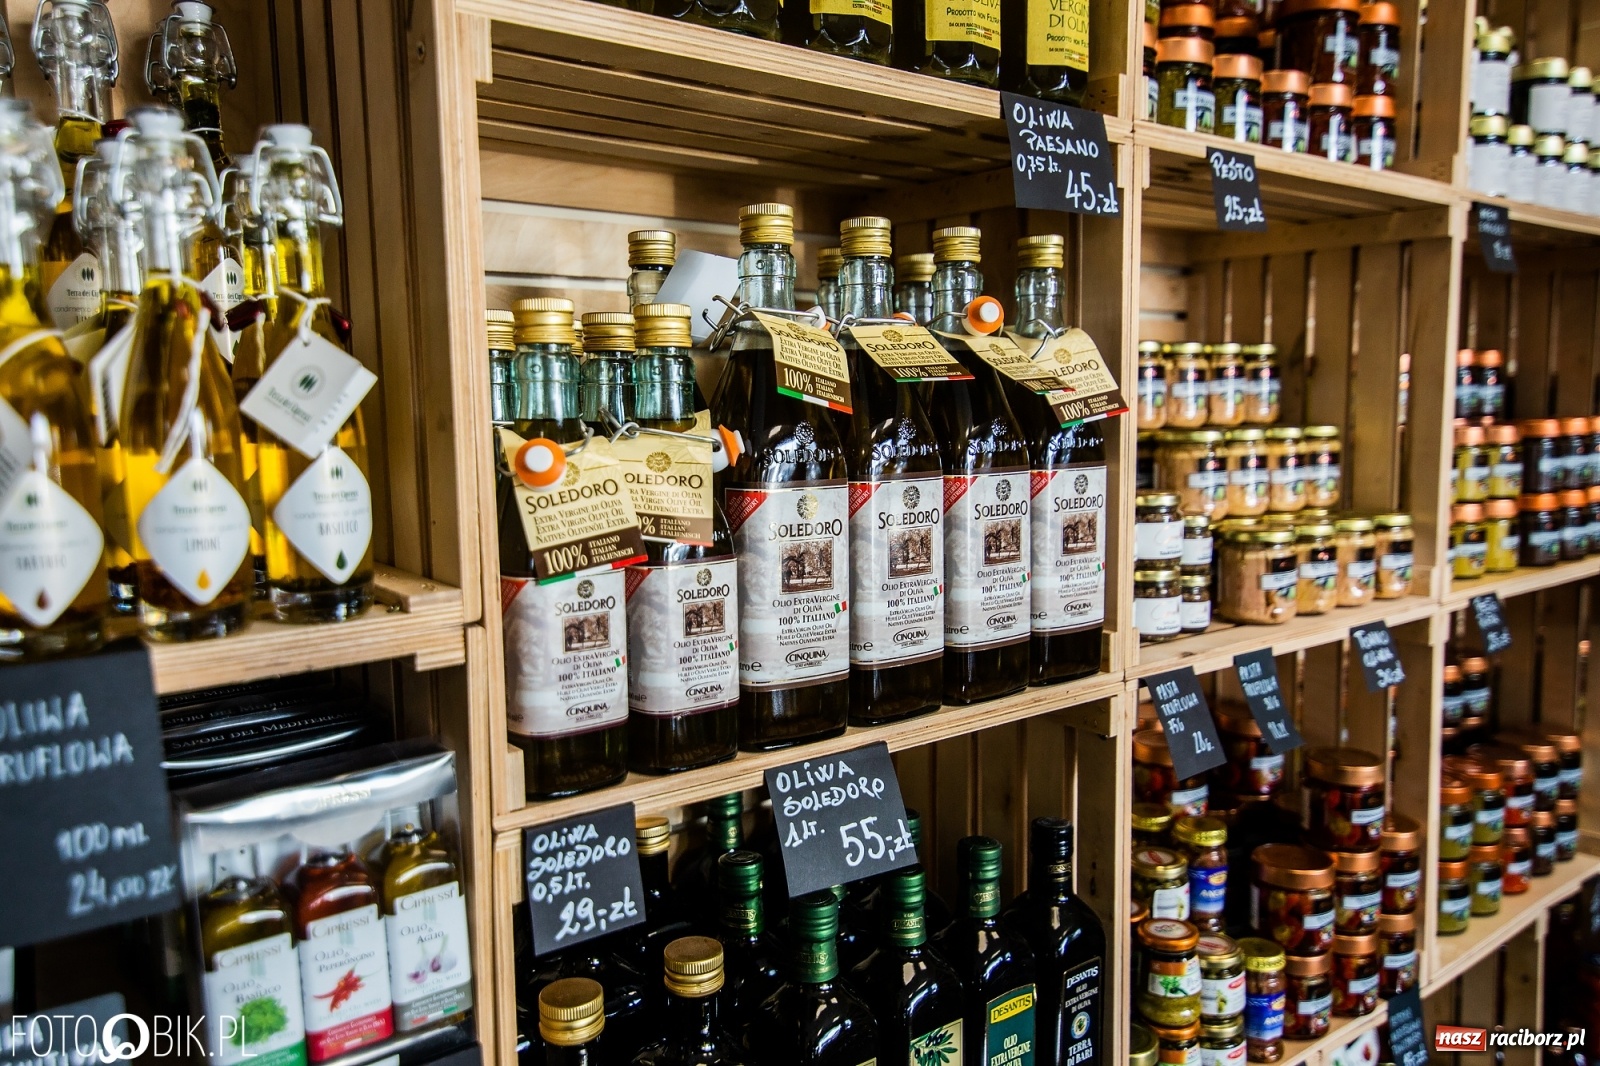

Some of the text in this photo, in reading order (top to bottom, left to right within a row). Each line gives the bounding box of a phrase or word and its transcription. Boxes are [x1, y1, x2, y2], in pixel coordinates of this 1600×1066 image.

[947, 7, 976, 17] PRODOTTO
[1049, 14, 1064, 28] DI
[1019, 129, 1099, 158] PAESANO
[1210, 151, 1254, 182] PESTO
[770, 326, 839, 352] SOLEDORO
[780, 337, 796, 349] EXTRA
[797, 342, 819, 355] VERGINE
[866, 341, 935, 353] SOLEDORO
[780, 352, 844, 378] NATIVES EXTRA
[781, 345, 842, 370] EXTRA VIRGIN OLIVE OIL
[986, 354, 1031, 366] SOLEDORO
[893, 366, 929, 378] 100%
[1050, 359, 1100, 378] OLEDORO
[783, 368, 813, 393] 100%
[1059, 400, 1090, 421] 100%
[624, 472, 703, 489] OLEDORO
[526, 478, 619, 515] SOLEDORO
[641, 488, 669, 497] VERGINE
[681, 490, 702, 499] OLIVA
[641, 496, 701, 507] VIRGIN OLIVE OIL
[1054, 494, 1104, 512] SOLEDORO
[533, 499, 623, 525] EXTRA VERGINE DI OLIVA
[682, 507, 704, 515] EXTRA
[878, 508, 940, 529] SOLEDORO
[974, 500, 1028, 520] SOLEDORO
[536, 507, 625, 535] EXTRA VIRGIN OLIVE OIL
[660, 518, 691, 526] ITALIANO
[660, 524, 686, 532] ITALIAN
[768, 518, 843, 541] SOLEDORO
[536, 517, 630, 545] NATIVES EXTRA
[544, 535, 620, 574] 100% ITALIANO
[591, 544, 617, 555] ITALIAN
[593, 547, 634, 563] ITALIENISCH
[677, 584, 730, 603] SOLEDORO
[981, 584, 998, 594] 100%
[555, 595, 616, 617] SOLEDORO
[772, 599, 792, 608] OLIO
[802, 604, 823, 614] OLIVA
[887, 594, 935, 608] 100% ITALIANO
[778, 612, 836, 626] 100% ITALIANO
[679, 656, 699, 665] 100%
[789, 649, 827, 662] CINQUINA
[230, 729, 259, 738] DEL
[0, 732, 135, 785] RUFLOWA
[783, 776, 884, 817] SOLEDORO
[56, 822, 110, 862] 100
[527, 835, 631, 881] SOLEDORO
[400, 889, 454, 911] CIPRESSI
[312, 915, 370, 939] CIPRESSI
[400, 923, 428, 936] OLIO
[417, 930, 444, 944] AGLIO
[1066, 966, 1099, 988] DESANTIS
[993, 996, 1031, 1020] DESANTIS
[1004, 1034, 1018, 1049] OLIO
[1068, 1038, 1092, 1056] TERRA
[991, 1040, 1031, 1066] EXTRA VERGINE
[1067, 1047, 1092, 1066] DI BARI
